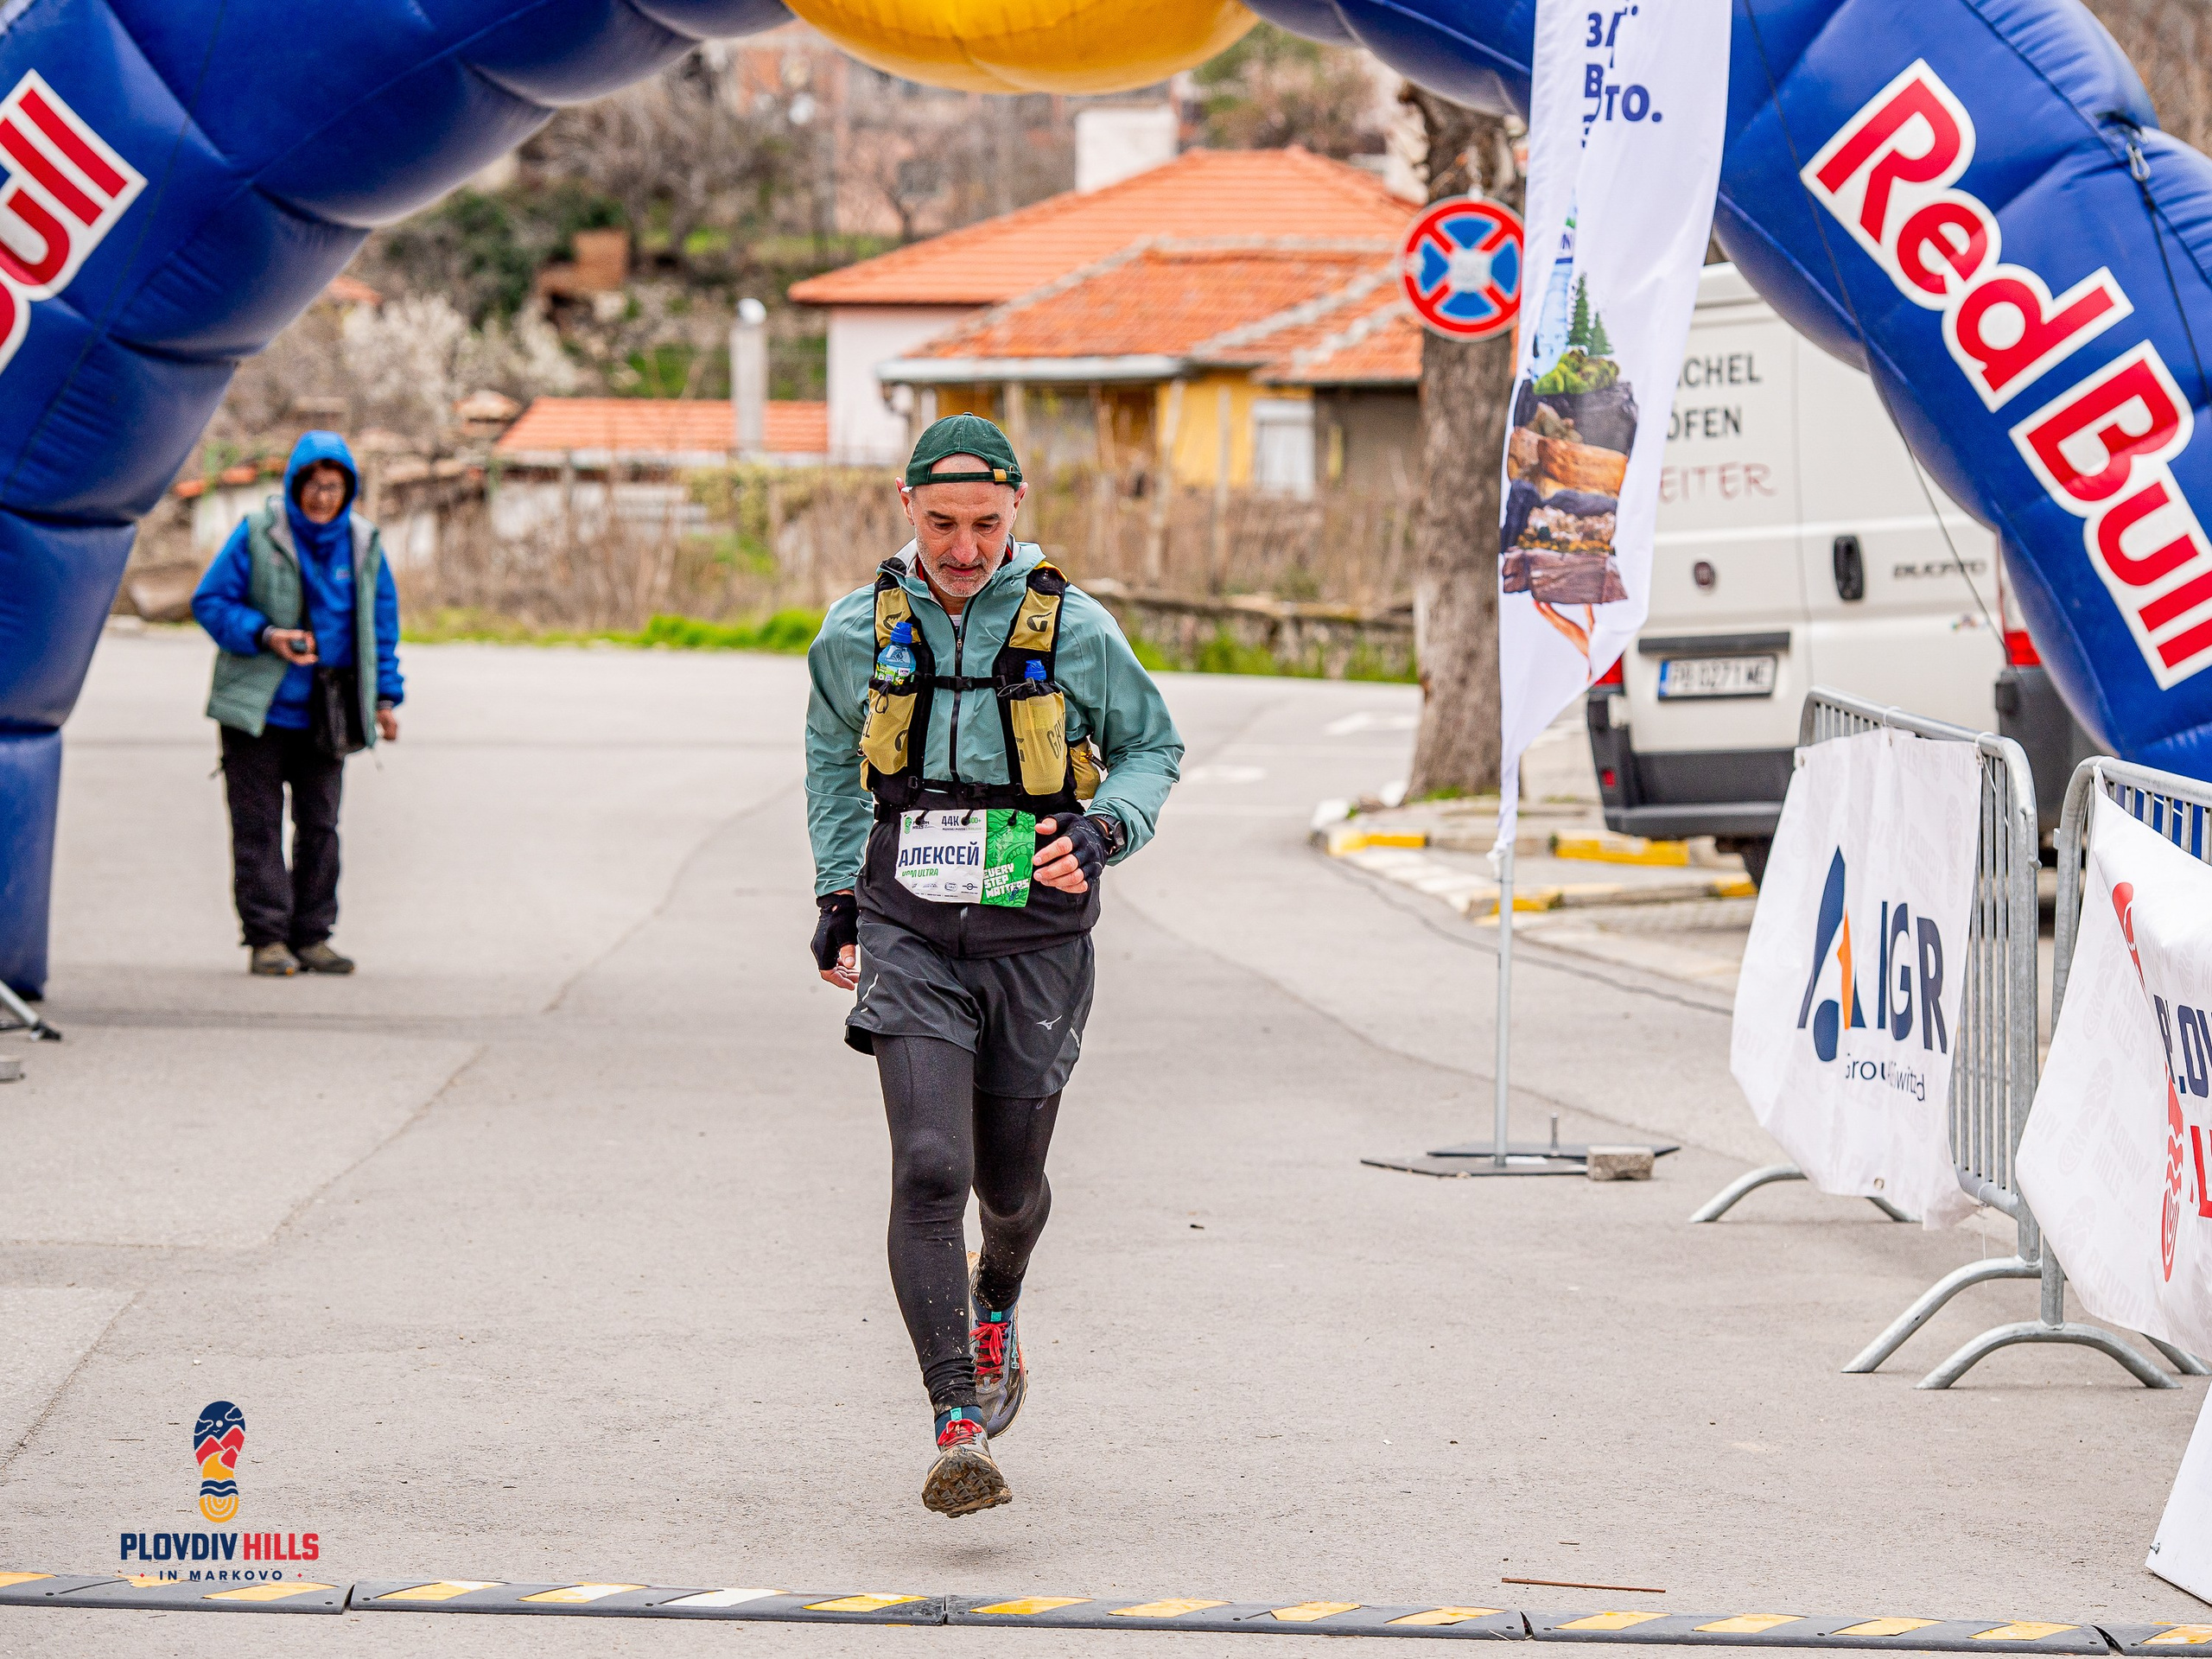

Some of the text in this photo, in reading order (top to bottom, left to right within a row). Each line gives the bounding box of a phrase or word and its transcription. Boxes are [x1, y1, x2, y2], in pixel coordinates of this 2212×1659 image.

[0, 79, 135, 350] ull
[1810, 71, 2122, 401] Red
[1677, 352, 1763, 389] CHEL
[941, 815, 960, 826] 44K
[898, 841, 980, 868] АЛЕКСЕЙ
[917, 868, 939, 878] ULTRA
[983, 862, 1014, 880] EVERY
[983, 874, 1009, 889] STEP
[985, 879, 1030, 899] MATTERS
